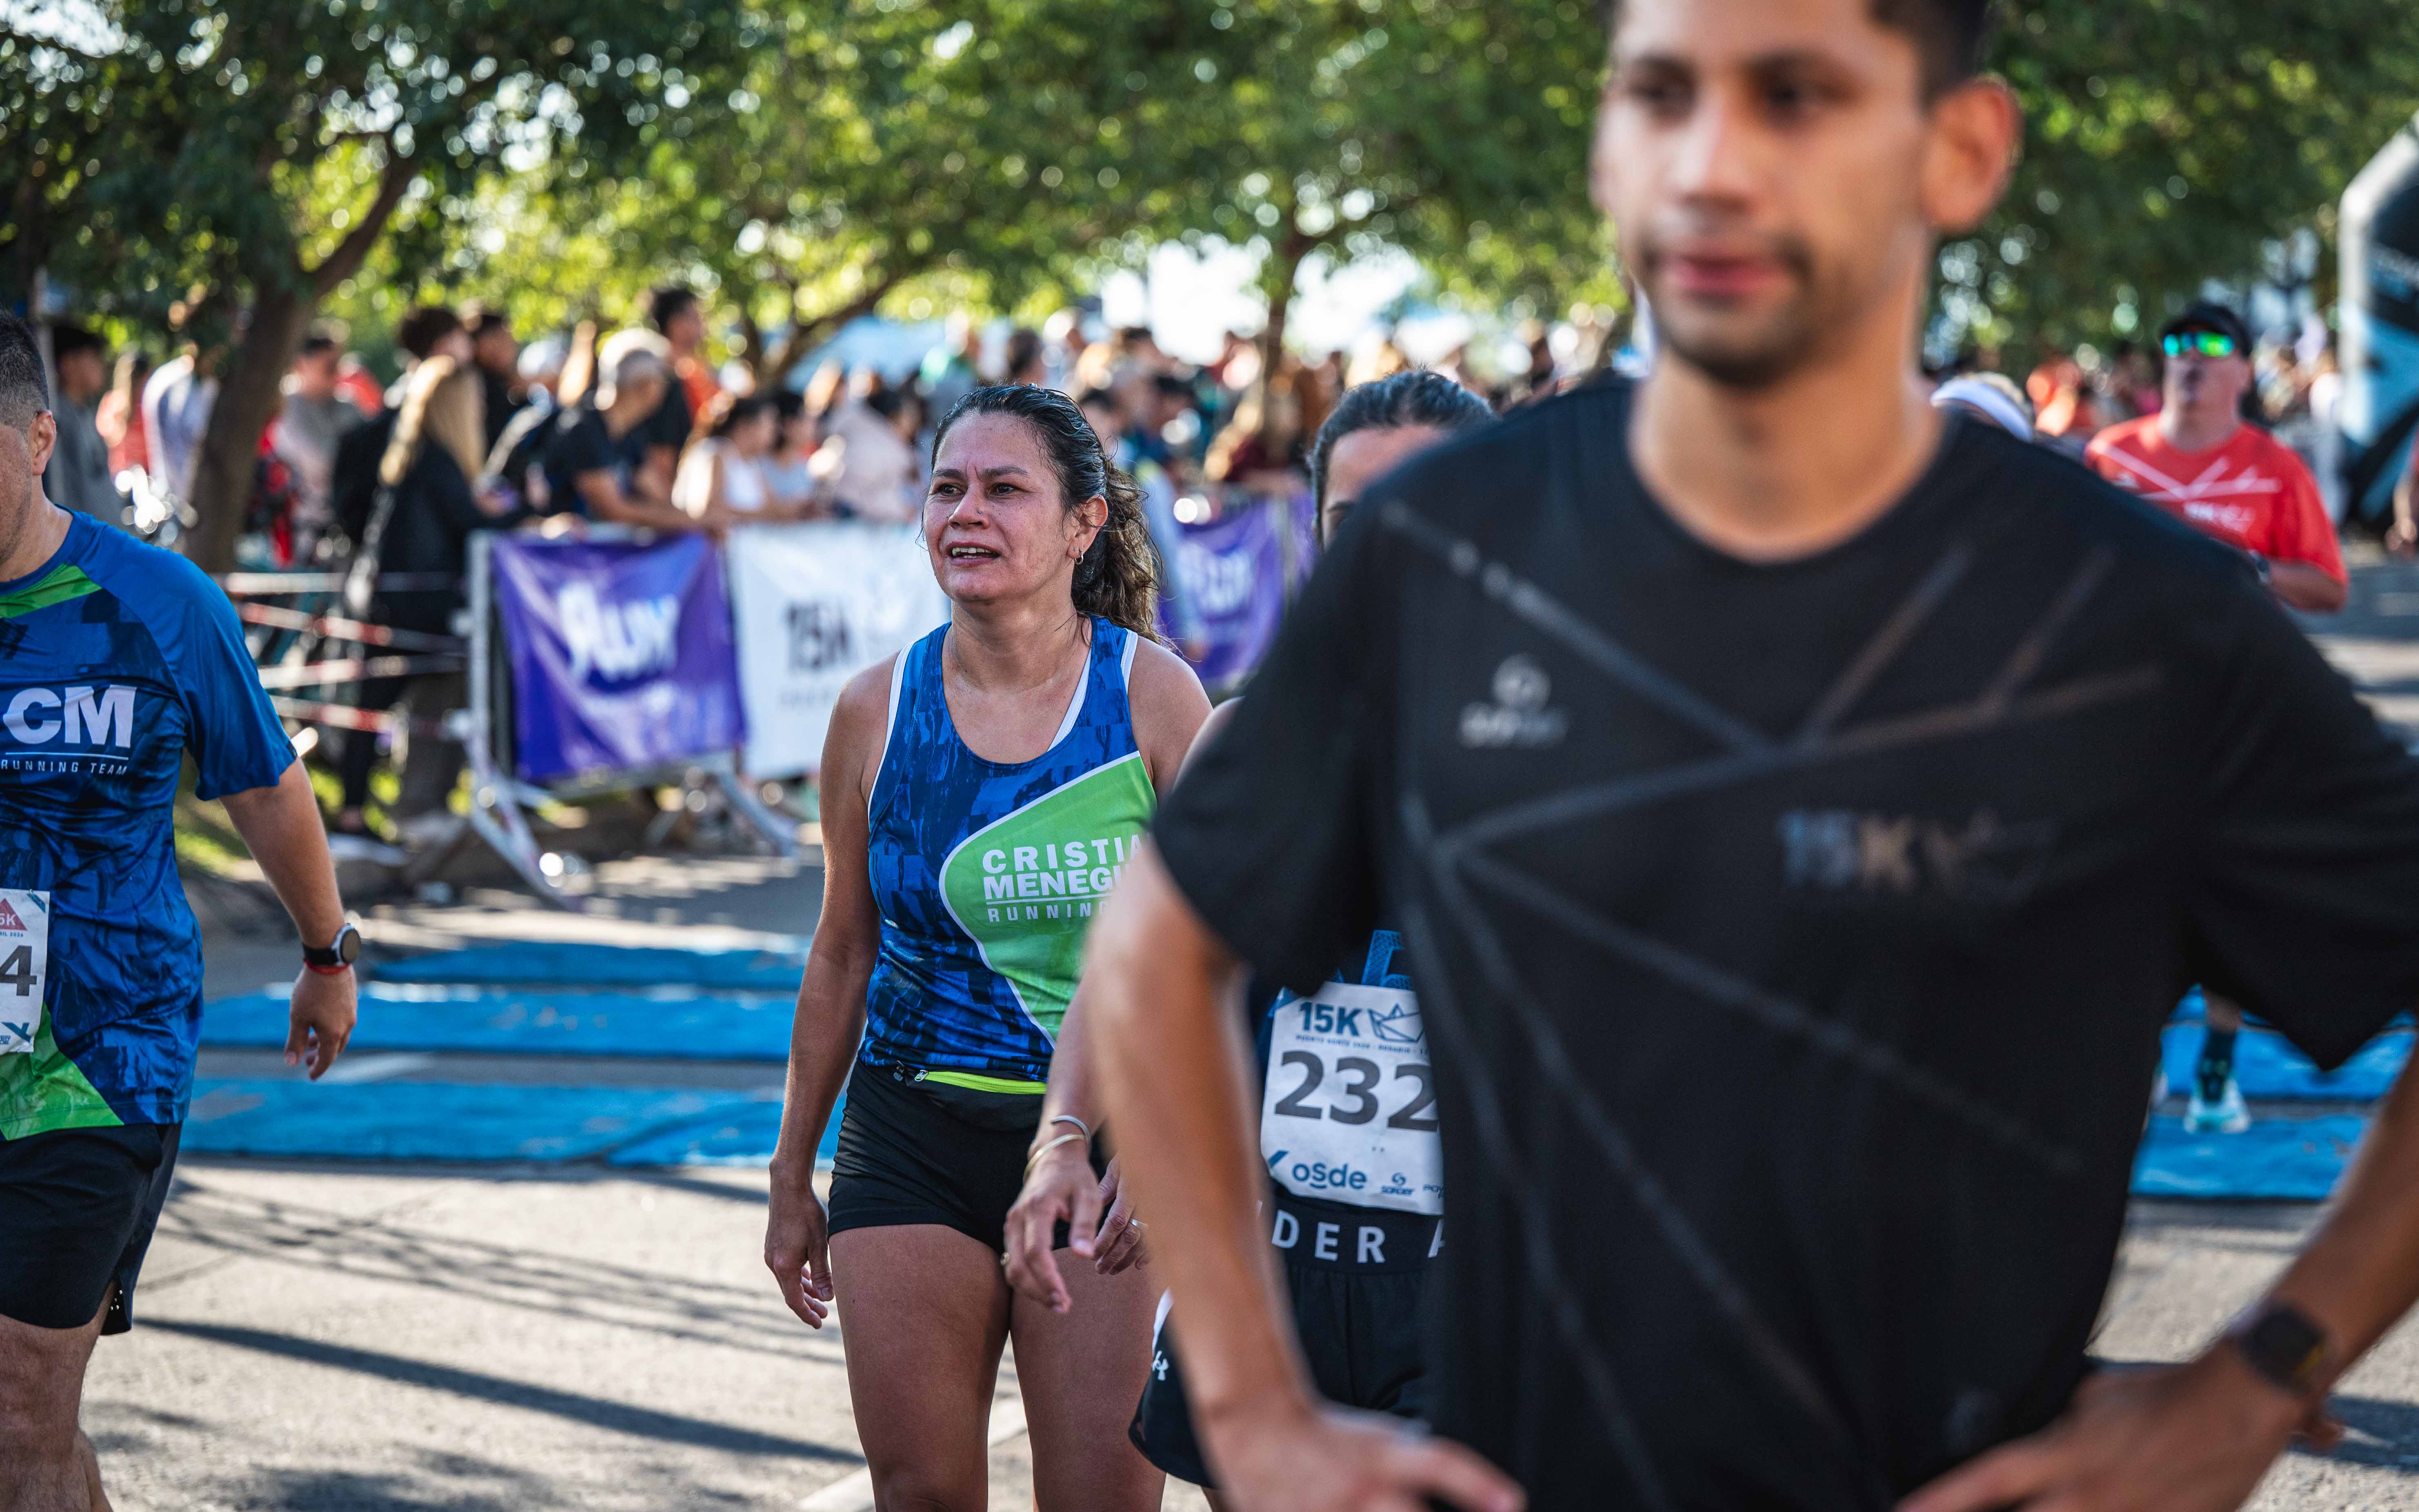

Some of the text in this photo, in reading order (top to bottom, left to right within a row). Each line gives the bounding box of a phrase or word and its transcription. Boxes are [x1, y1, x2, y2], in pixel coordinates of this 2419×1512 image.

[3, 684, 137, 748] CM
[1, 759, 127, 775] RUNNING TEAM
[982, 834, 1143, 873] CRISTIA
[1299, 1001, 1362, 1037] 15K
[1292, 1162, 1367, 1190] osde
[1271, 1209, 1386, 1263] DER
